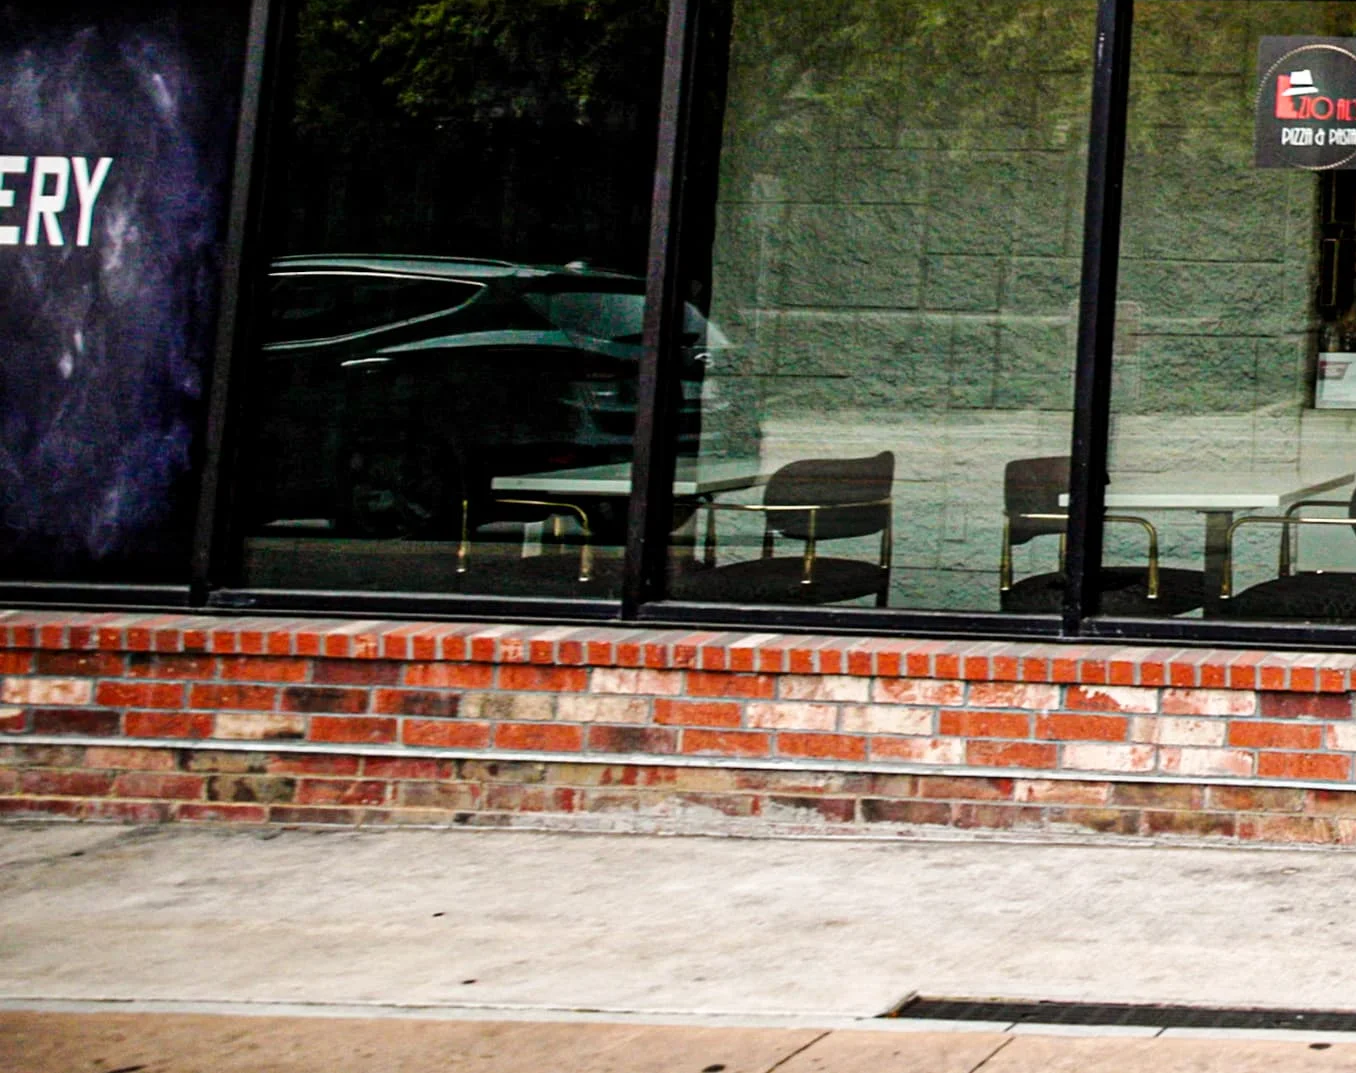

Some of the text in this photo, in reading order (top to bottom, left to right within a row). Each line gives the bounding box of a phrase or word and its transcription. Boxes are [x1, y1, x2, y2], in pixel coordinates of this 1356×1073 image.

[1298, 96, 1335, 120] ZIO
[1281, 127, 1313, 146] PIZZA
[1314, 128, 1326, 146] &
[0, 155, 114, 247] ERY
